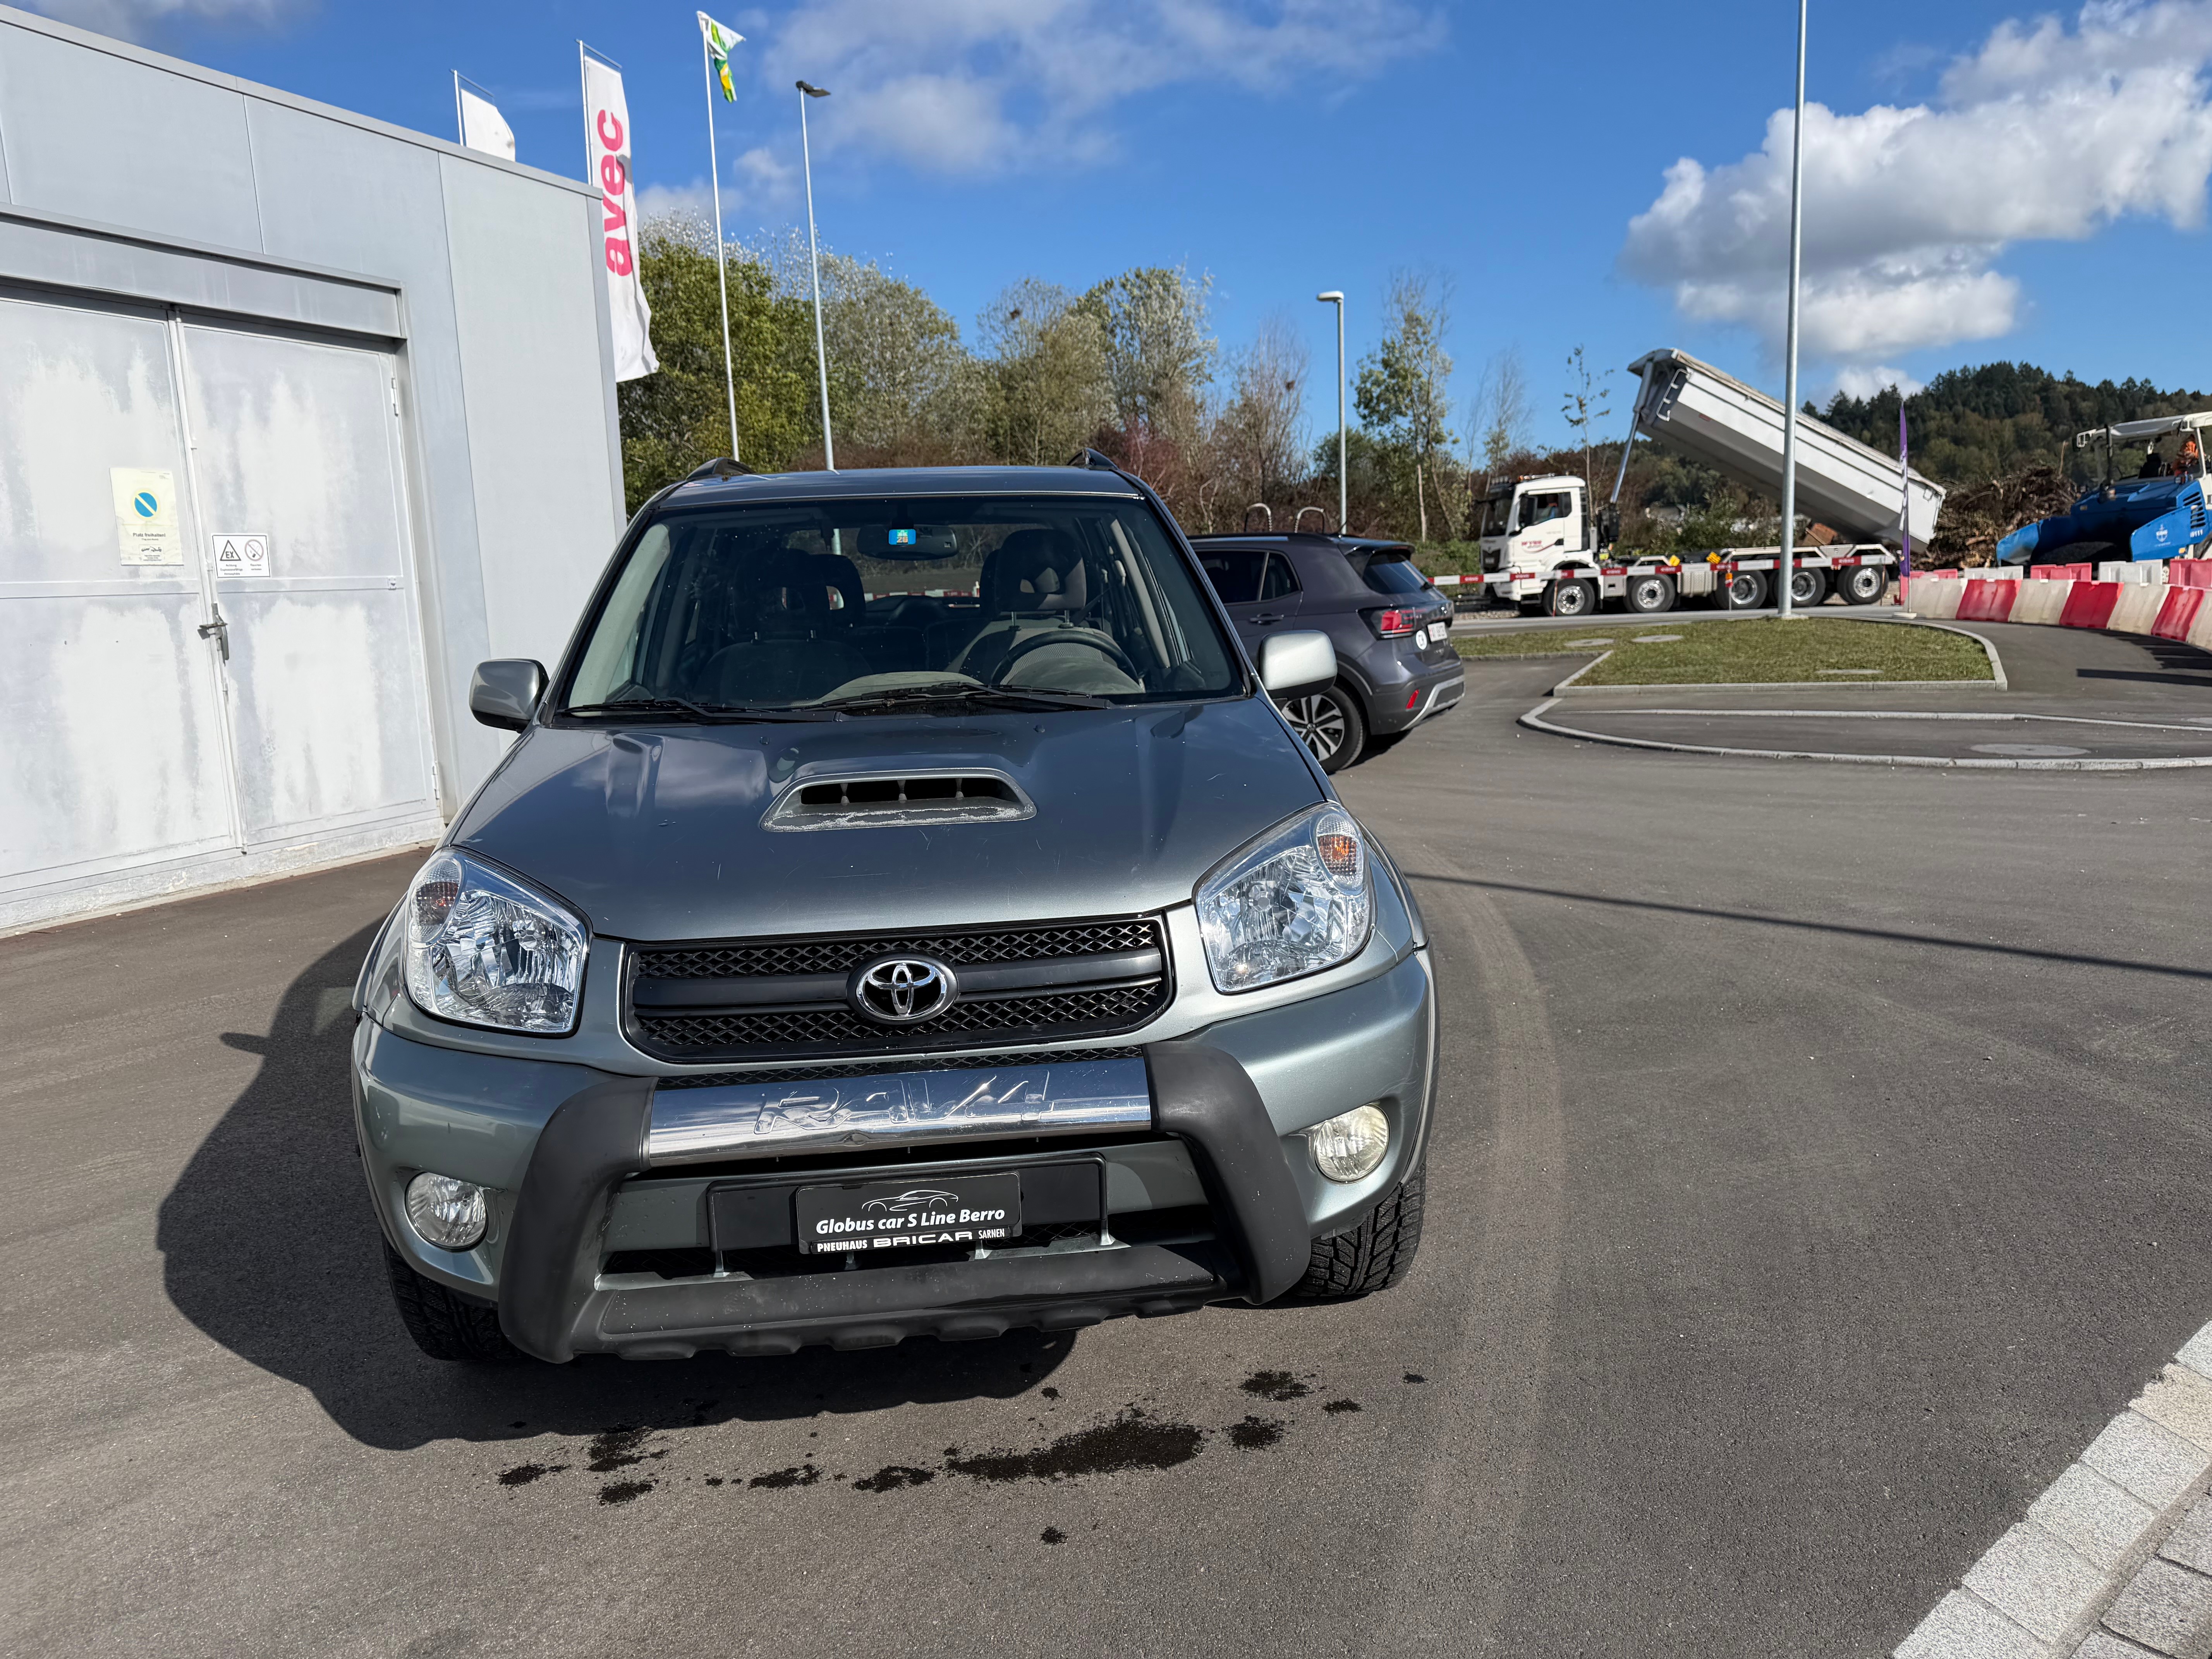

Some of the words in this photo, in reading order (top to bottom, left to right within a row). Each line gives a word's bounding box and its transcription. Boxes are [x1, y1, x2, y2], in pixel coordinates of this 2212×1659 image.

[597, 109, 633, 277] avec
[753, 1069, 1054, 1135] RAV4
[816, 1217, 875, 1235] Globus
[878, 1218, 904, 1230] car
[907, 1213, 917, 1228] S
[921, 1211, 955, 1226] Line
[959, 1209, 1005, 1223] Berro
[817, 1239, 868, 1252] PNEUHAUS
[873, 1231, 973, 1248] BRICAR
[978, 1228, 1005, 1239] SARNEN
